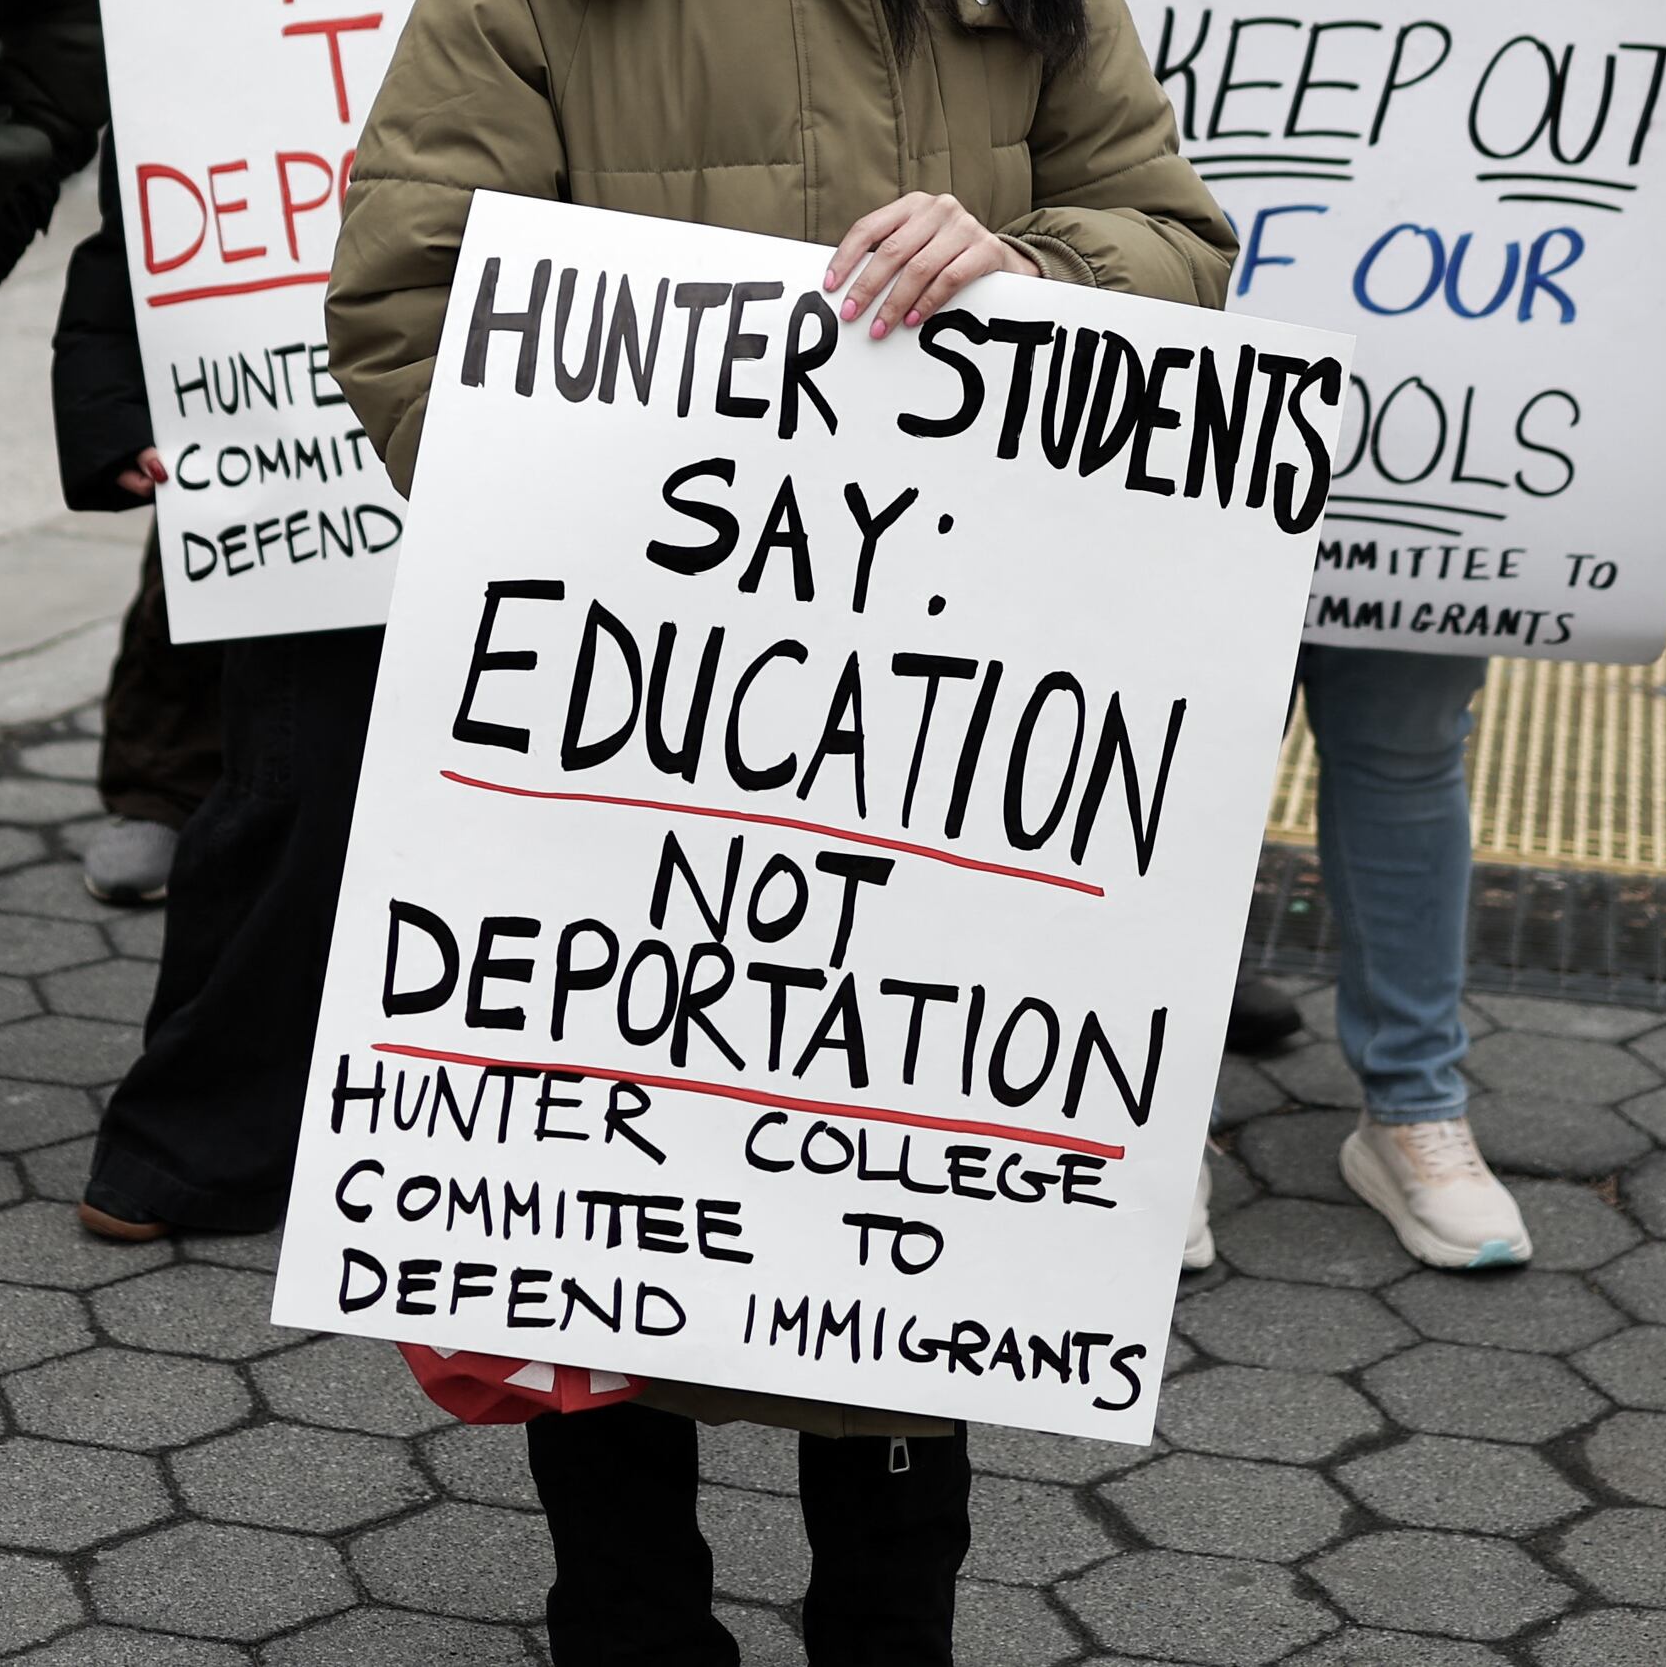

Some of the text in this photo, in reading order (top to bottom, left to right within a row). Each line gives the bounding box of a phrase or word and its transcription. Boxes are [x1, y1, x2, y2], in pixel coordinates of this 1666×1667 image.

[1155, 8, 1451, 145] KEEP
[1227, 205, 1585, 324] F OUR
[461, 258, 1341, 534] HUNTER STUDENTS
[183, 505, 402, 581] DEFEND
[646, 458, 953, 615] SAY:
[453, 579, 1186, 876] EDUCATION
[650, 831, 895, 969] NOT
[382, 898, 1167, 1126] DEPORTATION
[331, 1054, 1117, 1208] HUNTER COLLEGE
[336, 1160, 944, 1275] COMMITTEE TO
[338, 1246, 1145, 1410] DEFEND IMMIGRANTS
